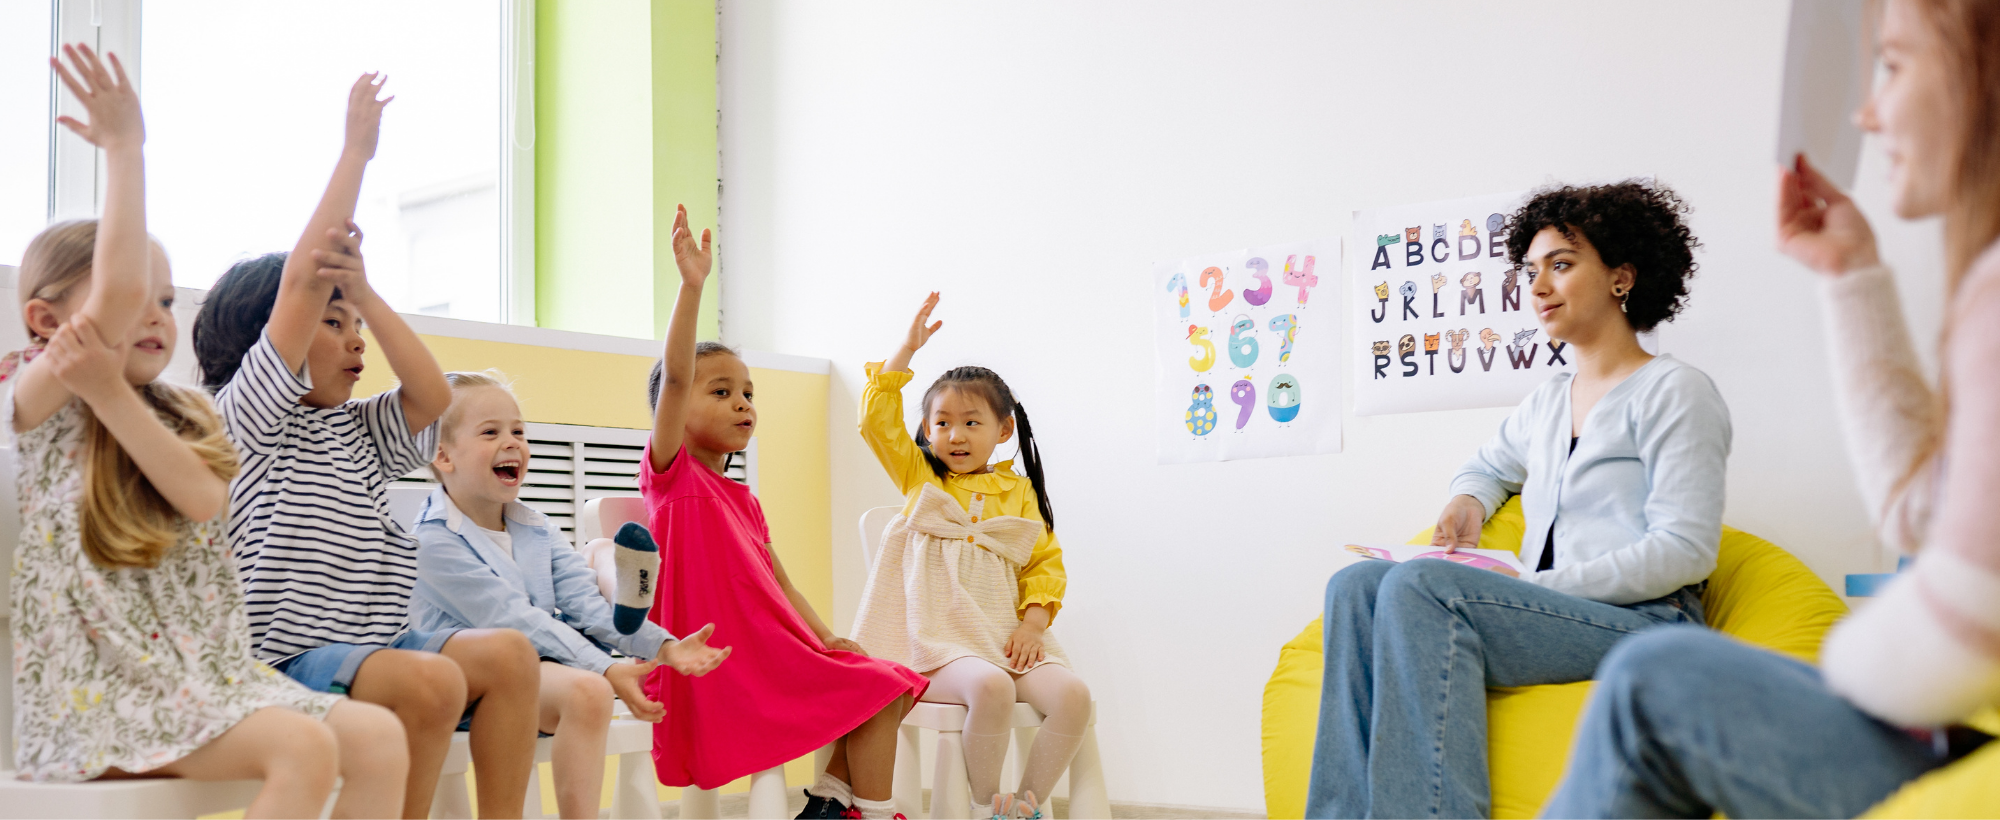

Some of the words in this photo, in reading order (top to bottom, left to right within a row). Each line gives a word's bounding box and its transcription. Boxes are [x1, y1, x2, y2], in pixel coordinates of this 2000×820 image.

[1371, 245, 1391, 270] A
[1406, 241, 1424, 267] B
[1431, 238, 1450, 263] C
[1458, 234, 1481, 261] D
[1166, 272, 1190, 318] 1
[1199, 266, 1234, 312] 2
[1243, 257, 1272, 306] 3
[1282, 254, 1318, 304] 4
[1371, 298, 1389, 323] J
[1403, 295, 1419, 321] K
[1433, 292, 1445, 318] L
[1460, 288, 1485, 316] M
[1228, 319, 1259, 368] 6
[1269, 314, 1297, 362] 7
[1374, 355, 1391, 380] R
[1400, 351, 1418, 377] S
[1425, 350, 1439, 376] T
[1448, 347, 1467, 374] U
[1477, 346, 1497, 372] V
[1506, 343, 1539, 370] W
[1185, 384, 1217, 436] 8
[1231, 380, 1256, 430] 9
[1267, 373, 1301, 423] 0
